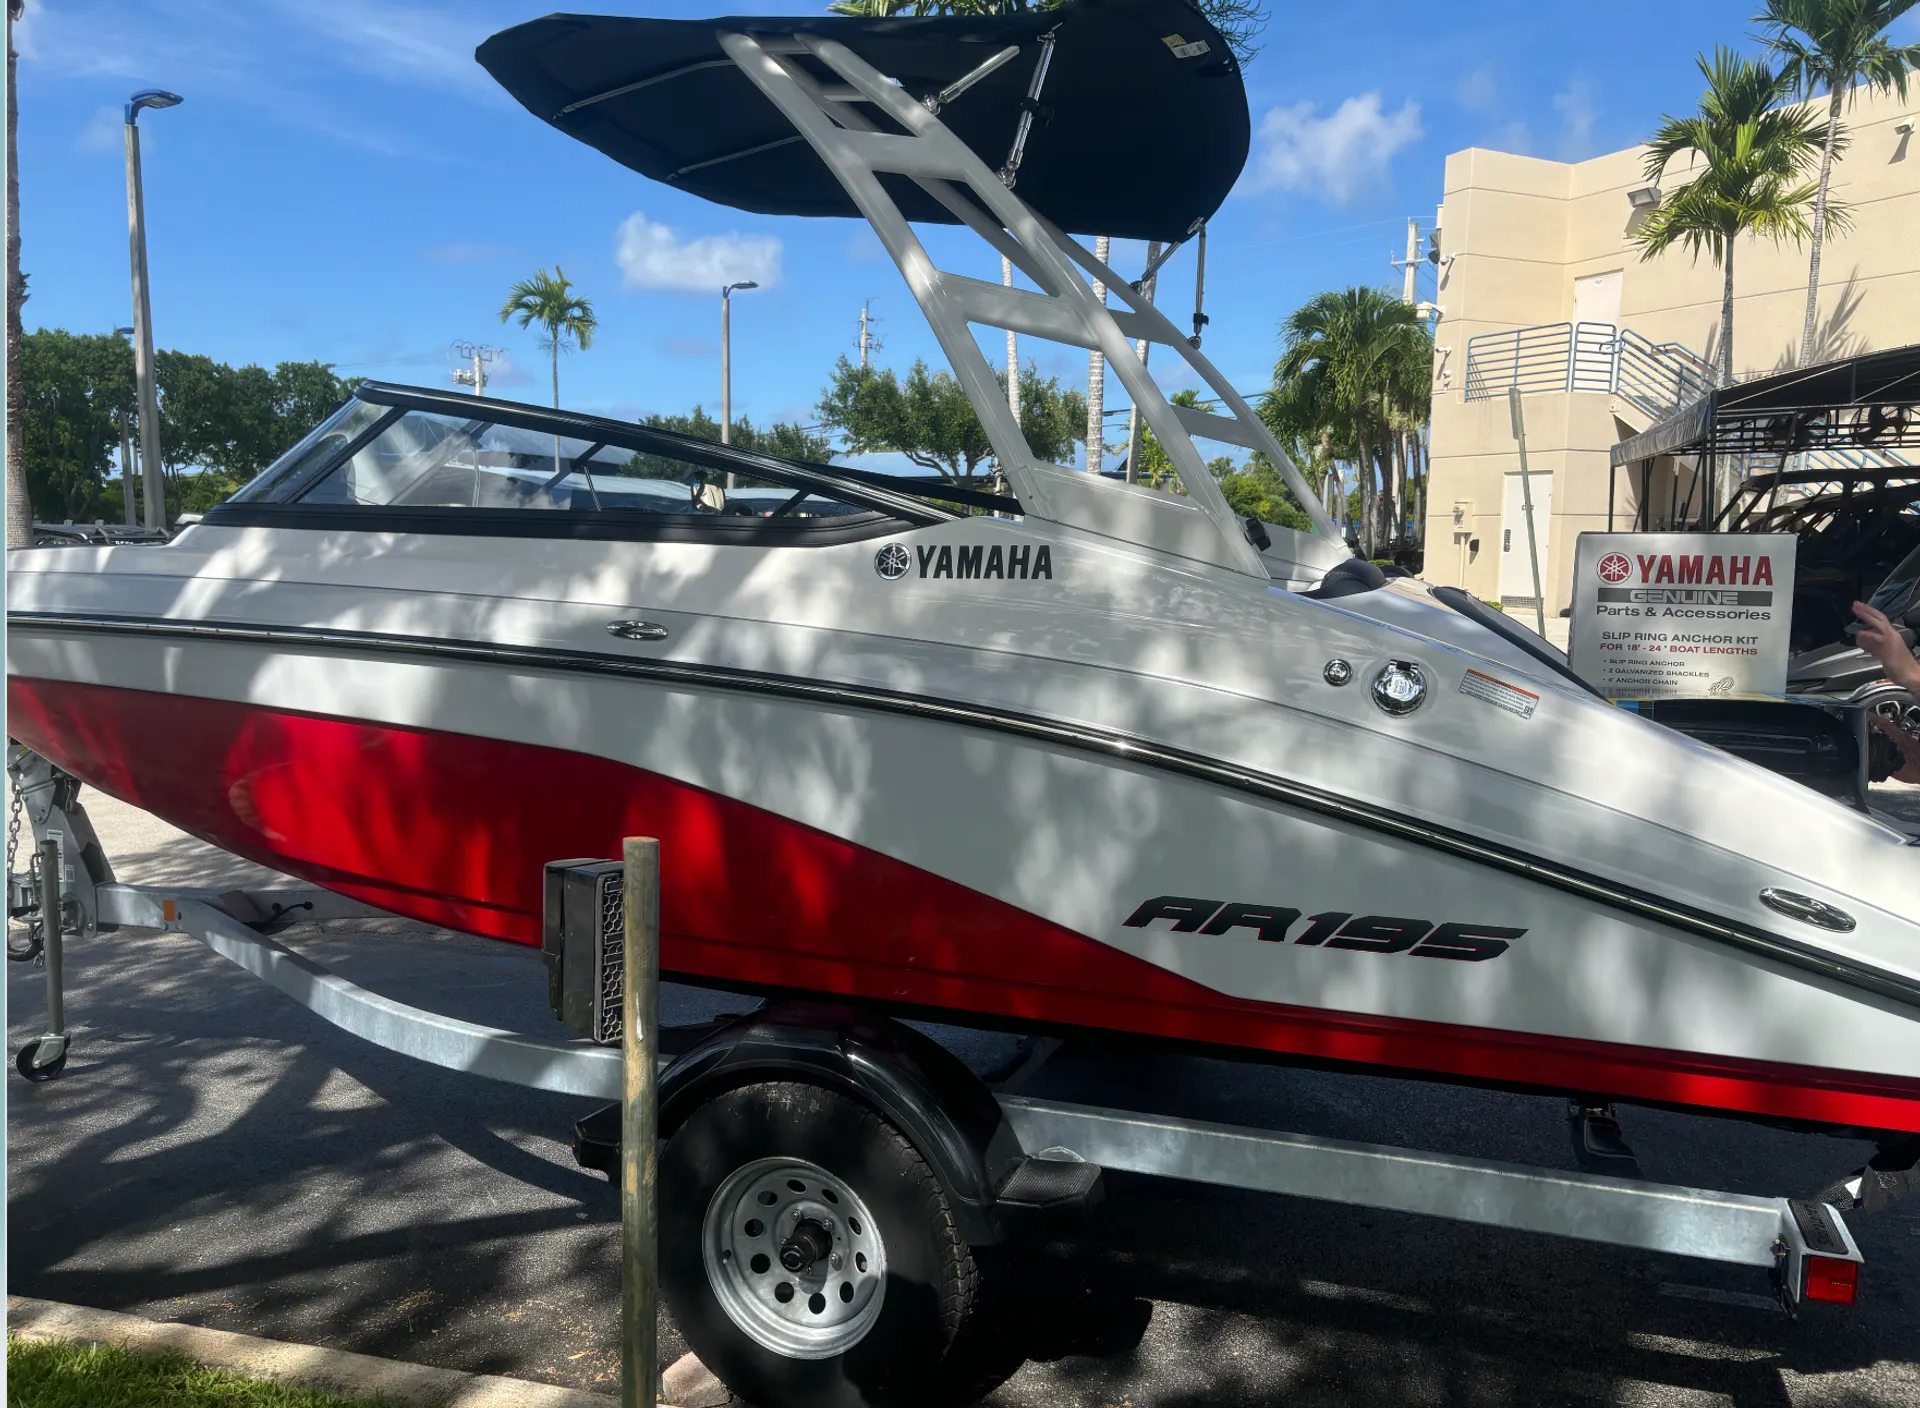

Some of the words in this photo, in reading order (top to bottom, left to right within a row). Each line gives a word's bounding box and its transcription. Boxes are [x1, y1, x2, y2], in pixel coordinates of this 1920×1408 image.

[916, 545, 1052, 579] YAMAHA
[1636, 554, 1773, 586] YAMAHA
[1629, 589, 1738, 605] GENUINE
[1596, 605, 1640, 617] Parts
[1644, 606, 1658, 617] &
[1662, 607, 1771, 621] Accessories
[1602, 631, 1631, 641] SLIP
[1634, 632, 1668, 642] RING
[1671, 634, 1733, 644] ANCHOR
[1736, 635, 1759, 645] KIT
[1600, 642, 1623, 651] FOR
[1627, 643, 1641, 651] 18'
[1669, 645, 1701, 654] BOAT
[1703, 646, 1758, 656] LENGTHS
[1615, 667, 1664, 676] GALVANIZED
[1666, 670, 1710, 678] SHACKLES
[1616, 677, 1650, 685] ANCHOR
[1652, 678, 1678, 686] CHAIN
[1121, 895, 1530, 962] AR195
